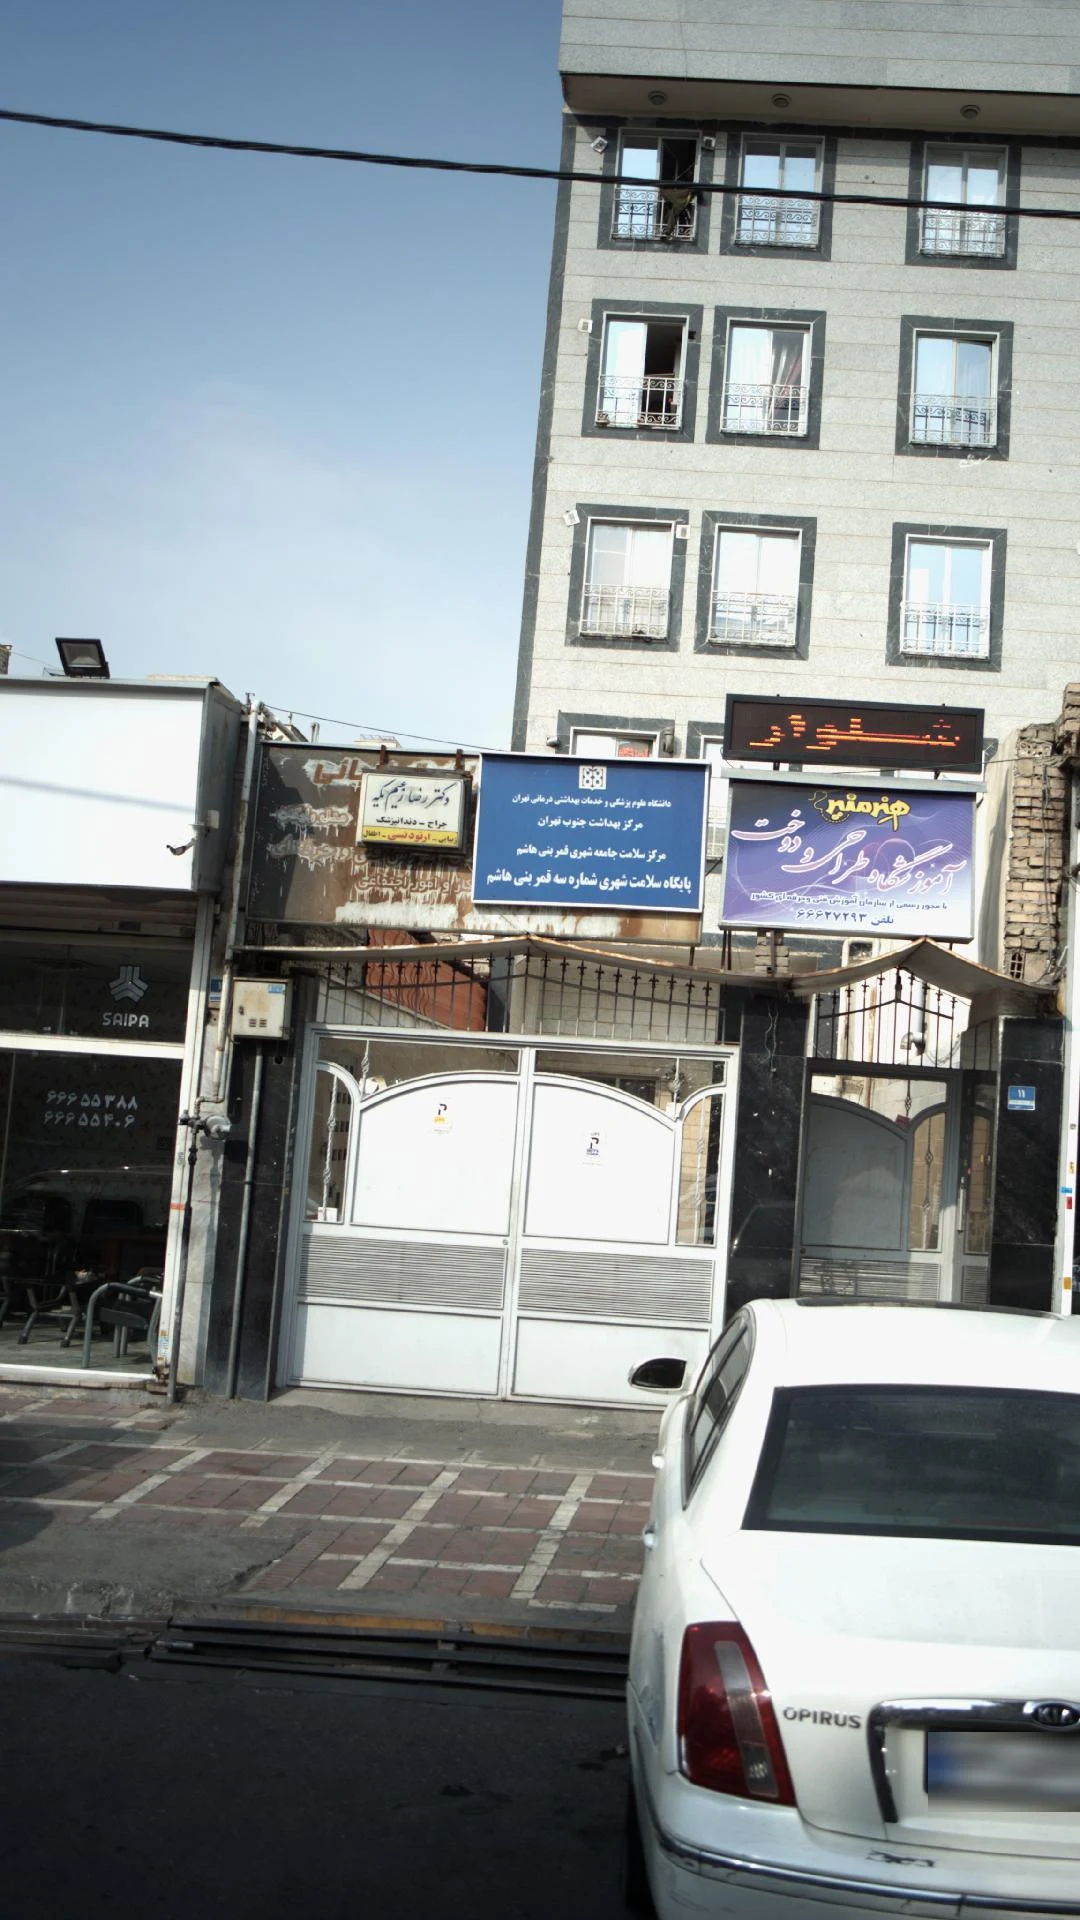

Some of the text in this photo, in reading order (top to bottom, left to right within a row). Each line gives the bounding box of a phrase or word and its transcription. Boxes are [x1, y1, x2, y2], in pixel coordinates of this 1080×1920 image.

[408, 785, 428, 803] رضا
[424, 781, 457, 809] دکتر
[512, 793, 672, 809] دانشگاه علوم پزشکی و خدمات بهداشتی درمانی تهران
[376, 816, 447, 829] جراح دندانپزشک
[537, 815, 644, 832] مرکز بهداشت جنوب تهران
[516, 844, 667, 863] مرکز سلامت جامعه شهری قمر بنی هاشم
[730, 808, 968, 895] آموزشگاه طراحی و دوخت
[487, 867, 692, 894] پایگاه سلامت شهری شماره سه قمر بنی هاشم
[859, 898, 887, 907] سازمان
[871, 914, 894, 926] تلفن
[102, 1012, 150, 1028] SAIPA
[783, 1706, 863, 1729] OPIRUS
